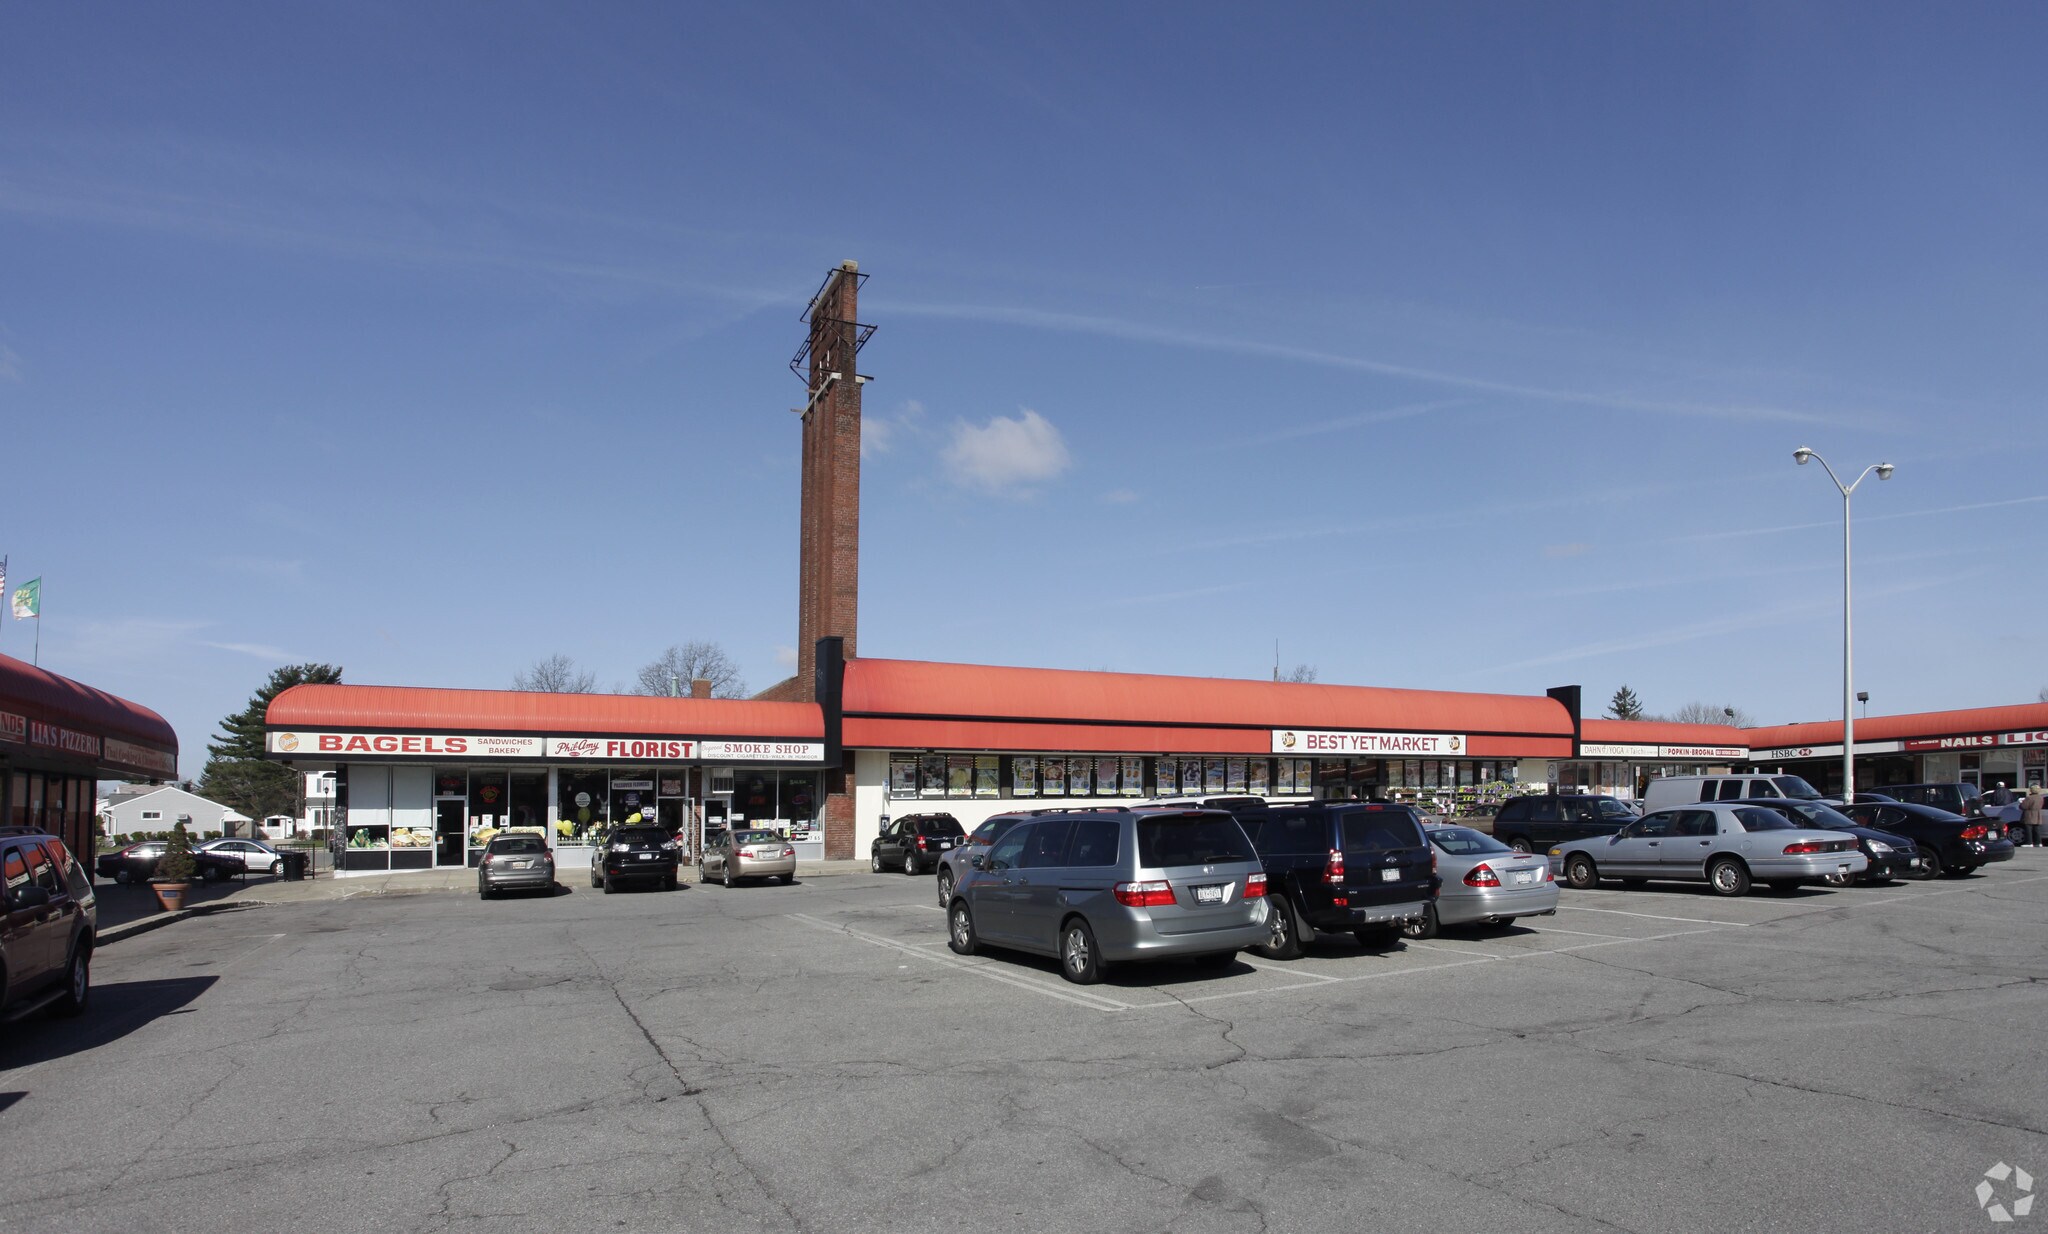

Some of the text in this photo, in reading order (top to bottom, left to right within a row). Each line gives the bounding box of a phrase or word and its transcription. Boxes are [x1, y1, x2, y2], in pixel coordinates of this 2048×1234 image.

[31, 722, 57, 747] LIA'S
[60, 728, 101, 756] PIZZERIA
[318, 735, 468, 753] BAGELS
[1307, 734, 1347, 750] BEST
[1350, 735, 1378, 750] YET
[1379, 737, 1439, 751] MARKET
[1940, 735, 1993, 748] NAILS
[607, 741, 693, 757] FLORIST
[724, 743, 771, 754] SMOKE
[775, 744, 810, 754] SHOP
[1584, 745, 1602, 754] DAHN
[1609, 746, 1625, 754] YOGA
[1771, 749, 1797, 759] HSBC
